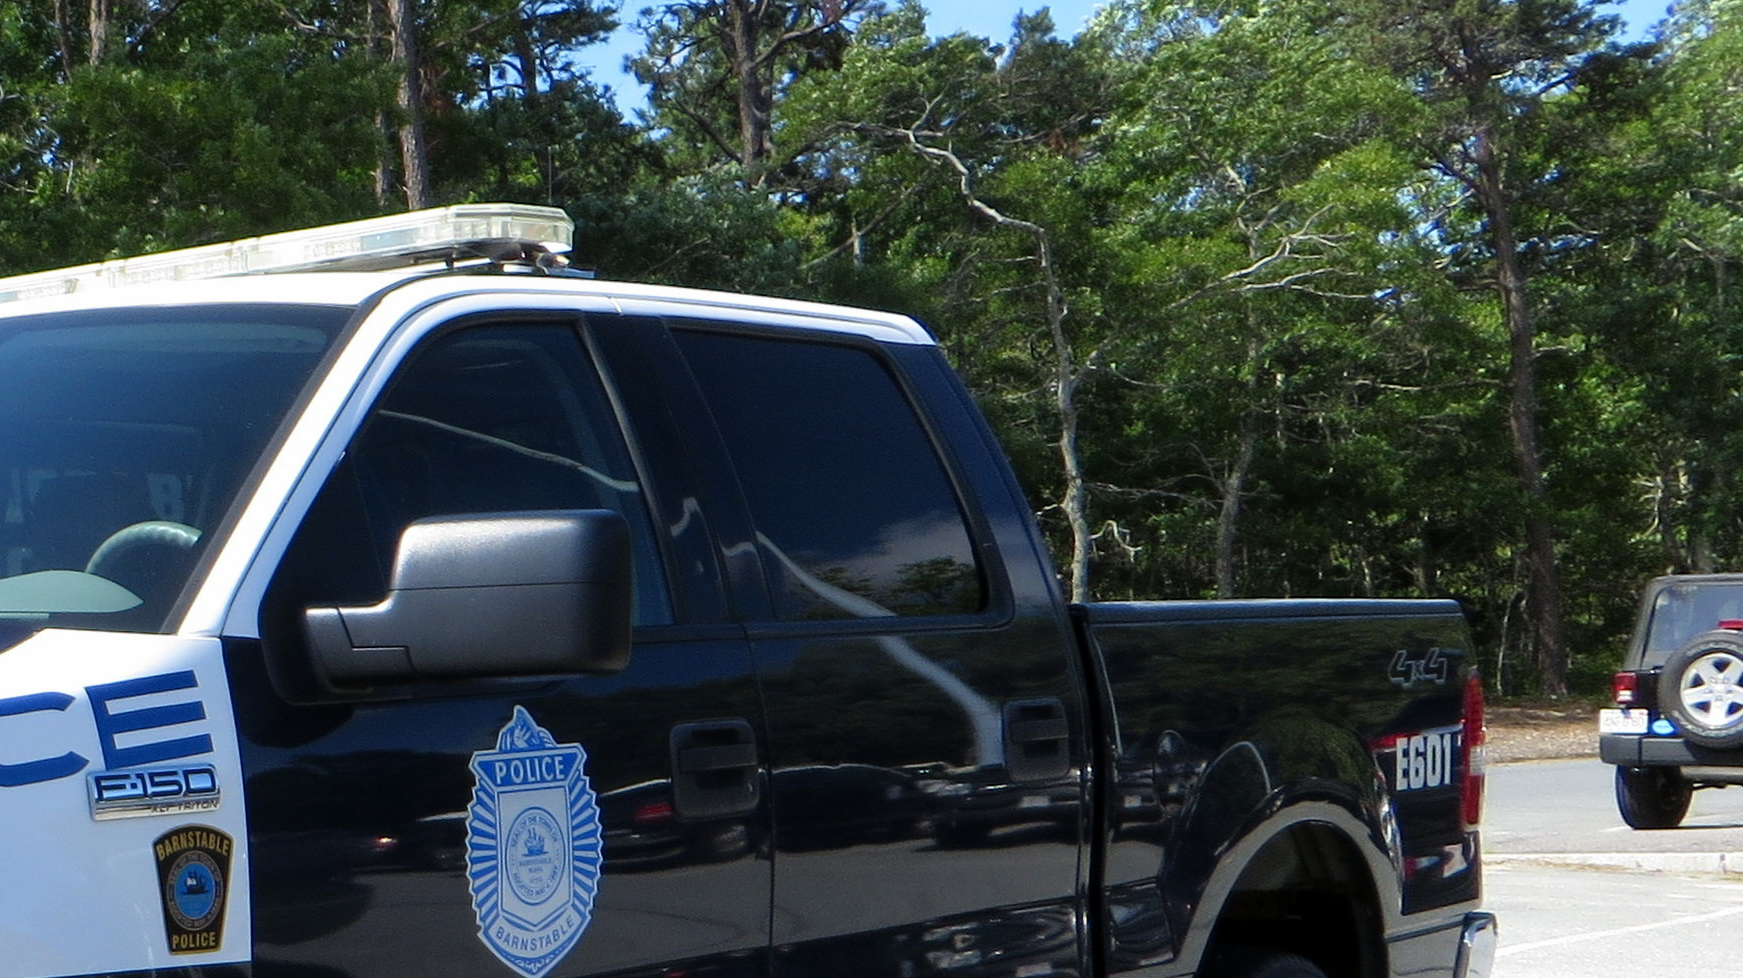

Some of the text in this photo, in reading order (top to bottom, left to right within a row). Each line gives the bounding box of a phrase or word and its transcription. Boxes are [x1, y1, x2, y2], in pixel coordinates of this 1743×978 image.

[495, 756, 565, 785] POLICE
[1396, 733, 1452, 792] E601
[94, 767, 216, 801] F-150
[156, 830, 230, 861] BARNSTABLE
[172, 931, 216, 949] POLICE
[495, 914, 575, 952] BARNSTABLE
